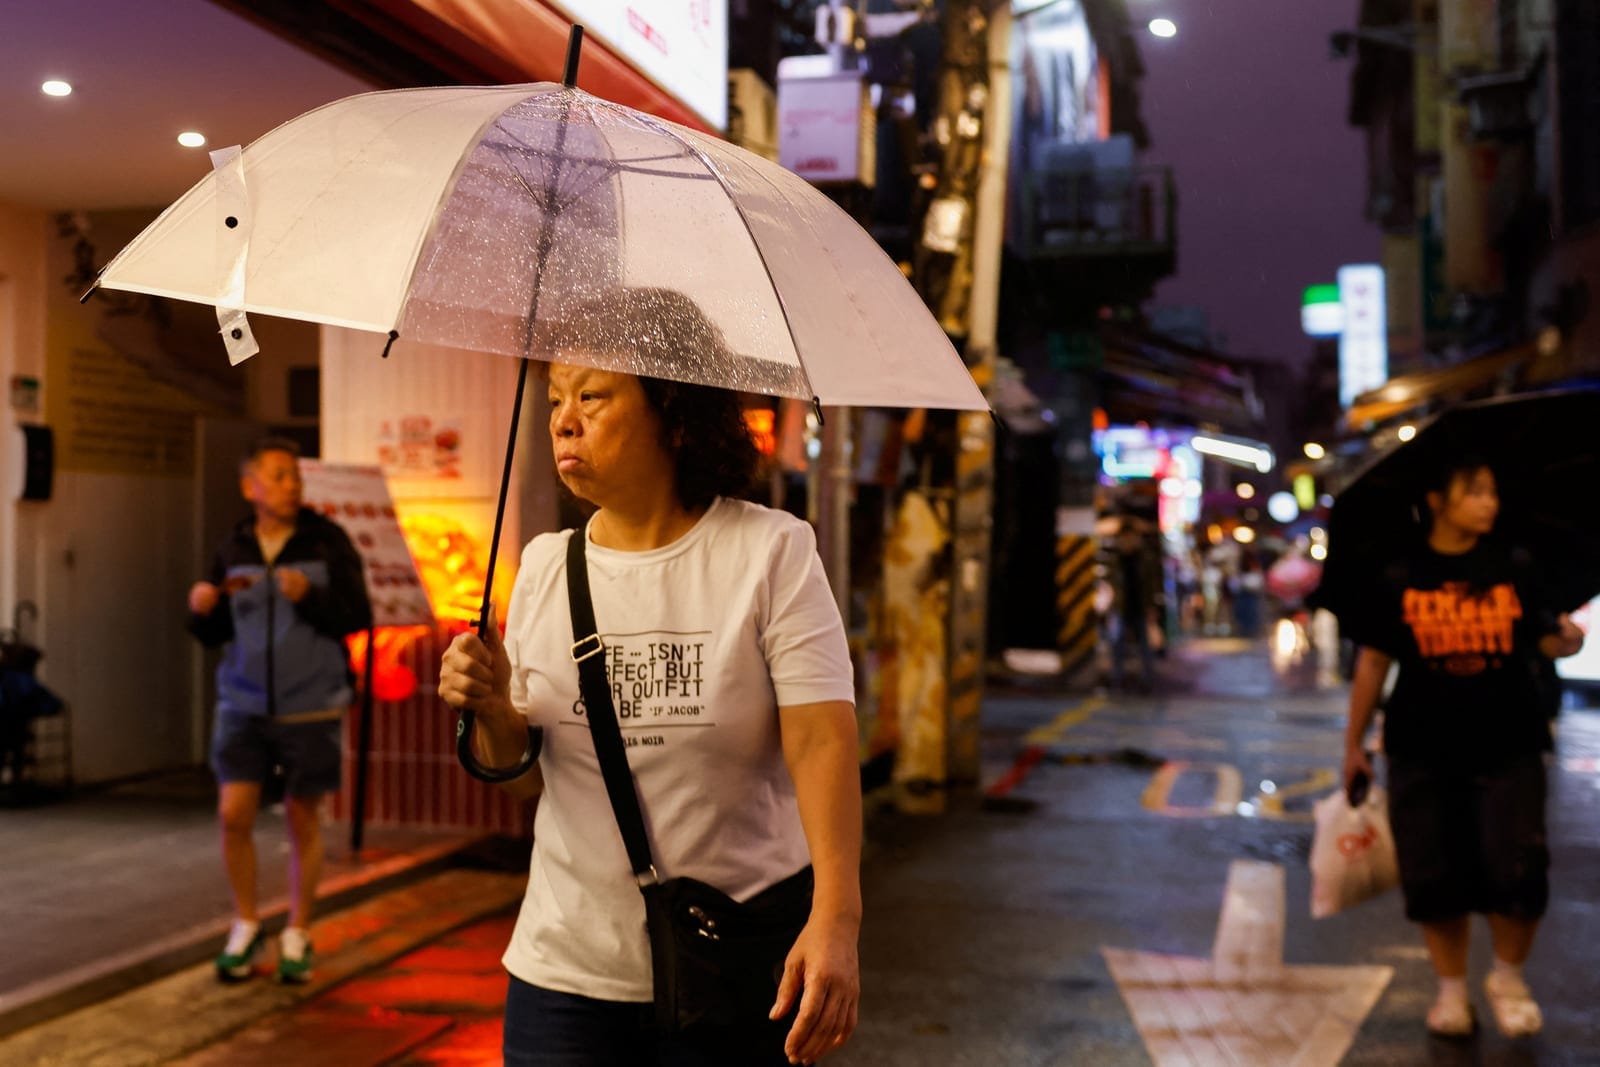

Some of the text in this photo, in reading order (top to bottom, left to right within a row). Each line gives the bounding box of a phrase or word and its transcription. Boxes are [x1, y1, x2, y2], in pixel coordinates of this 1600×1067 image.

[605, 645, 624, 663] FE
[648, 643, 704, 662] ISN'T
[605, 661, 704, 681] RFECT BUT
[632, 679, 703, 700] OUTFIT
[620, 699, 642, 718] BE
[642, 735, 664, 745] NOIR
